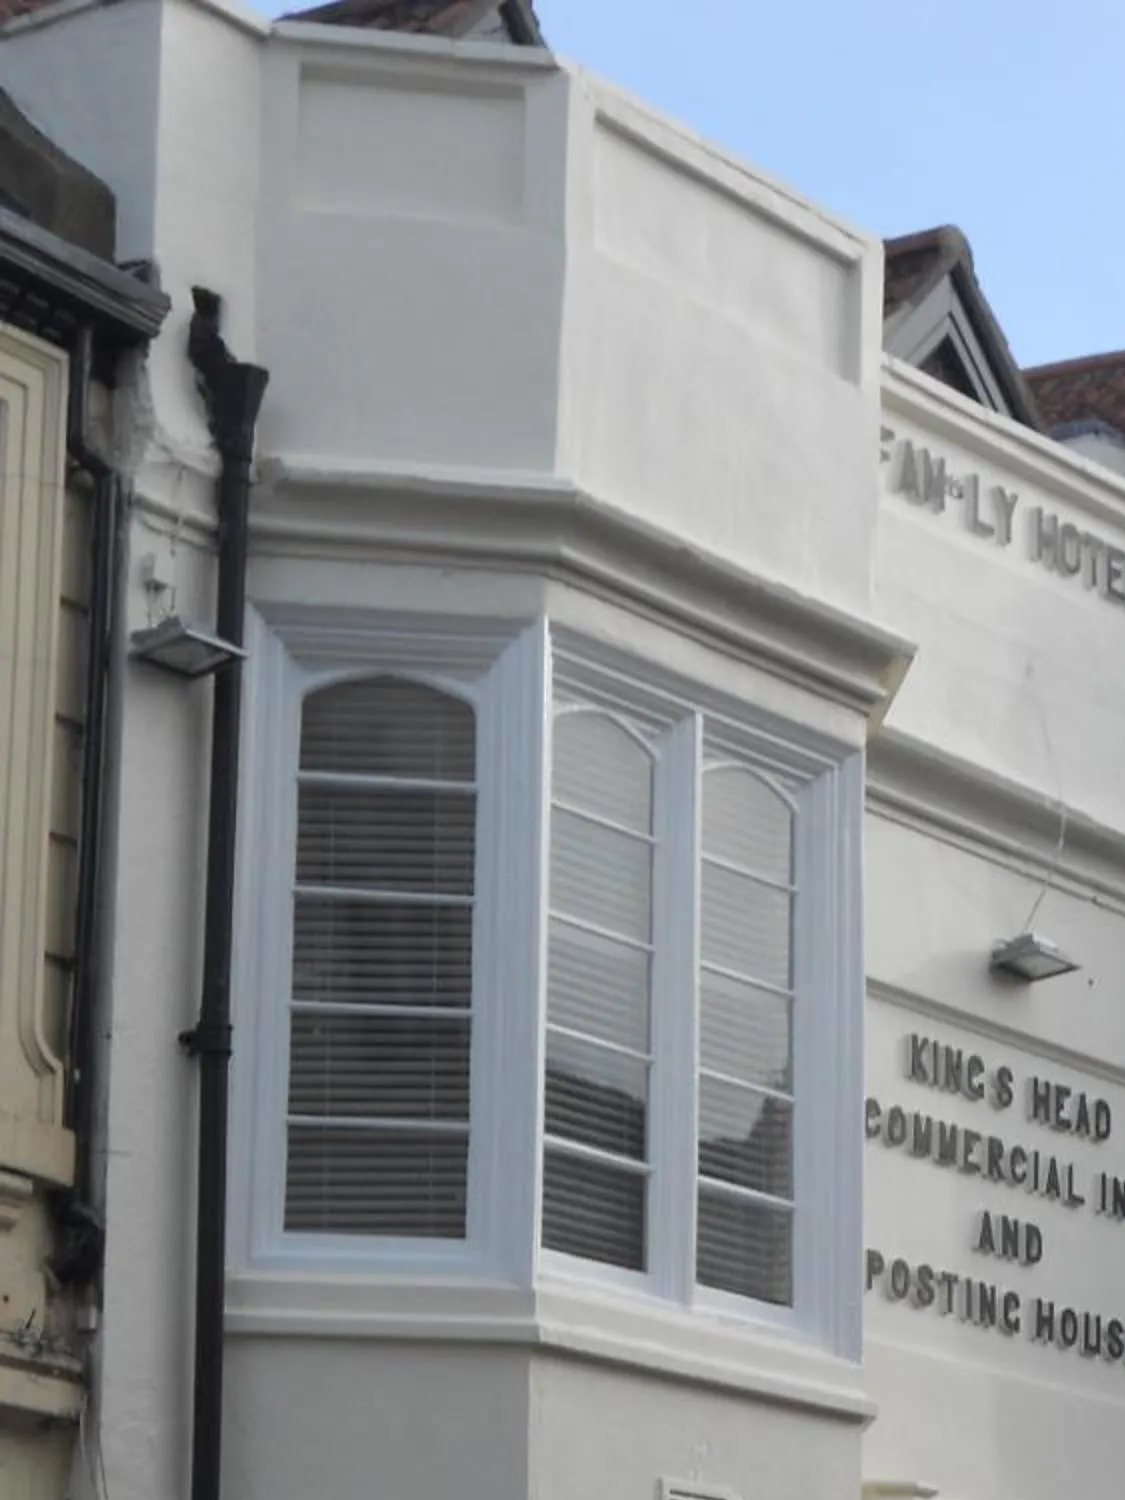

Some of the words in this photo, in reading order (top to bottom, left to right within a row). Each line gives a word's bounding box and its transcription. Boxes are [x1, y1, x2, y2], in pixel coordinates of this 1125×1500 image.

[1026, 1075, 1111, 1142] HEAD
[865, 1098, 1085, 1207] COMMERCIAL
[972, 1210, 1043, 1265] AND
[865, 1249, 1021, 1333] POSTING
